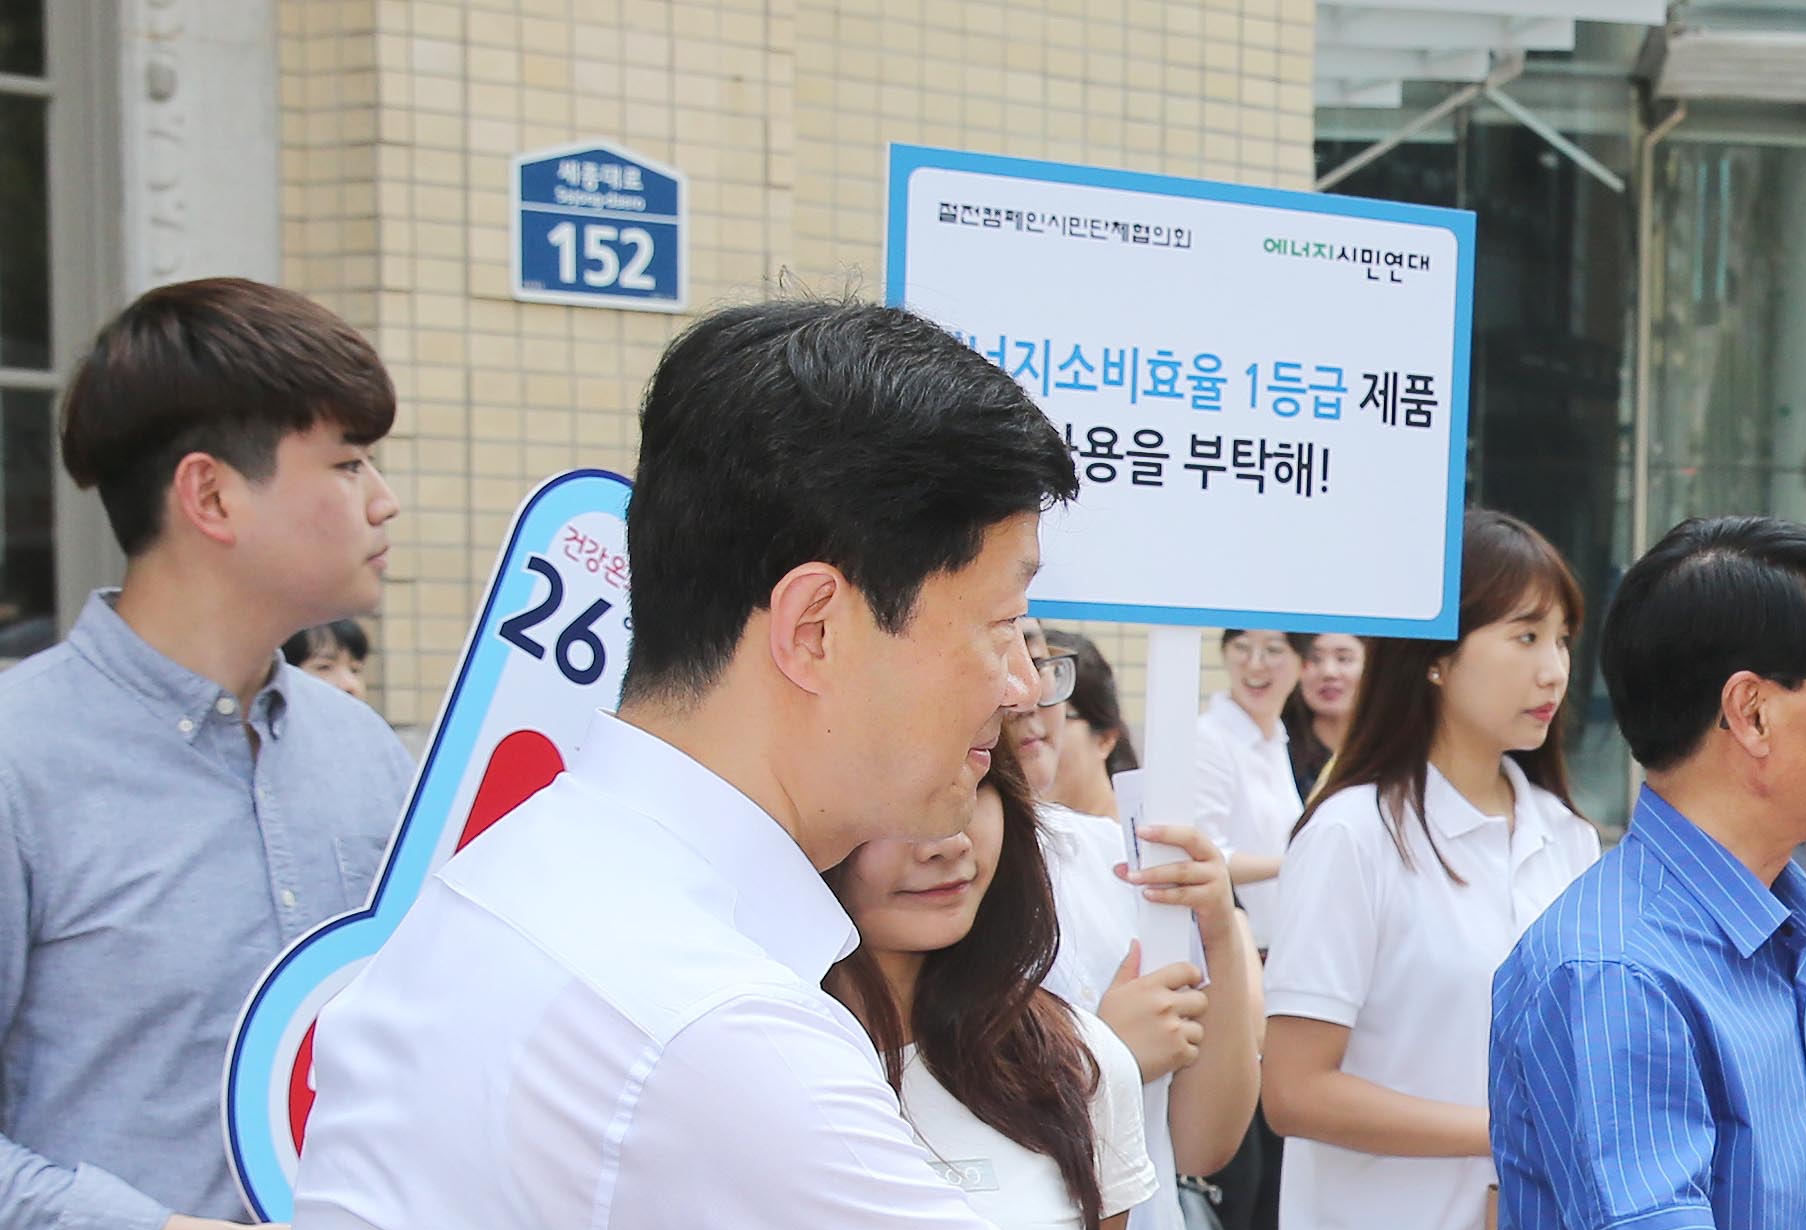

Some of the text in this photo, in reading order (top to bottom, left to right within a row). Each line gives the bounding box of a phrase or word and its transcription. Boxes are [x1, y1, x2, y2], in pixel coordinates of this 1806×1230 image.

[547, 221, 657, 291] 152
[938, 202, 1193, 249] 절전캠페인시민단체협의회
[1263, 237, 1432, 283] 에너지시민연대
[1244, 360, 1348, 420] 1등급
[1359, 370, 1438, 428] 제품
[1183, 433, 1330, 498] 부탁해!
[564, 525, 631, 590] 건강온
